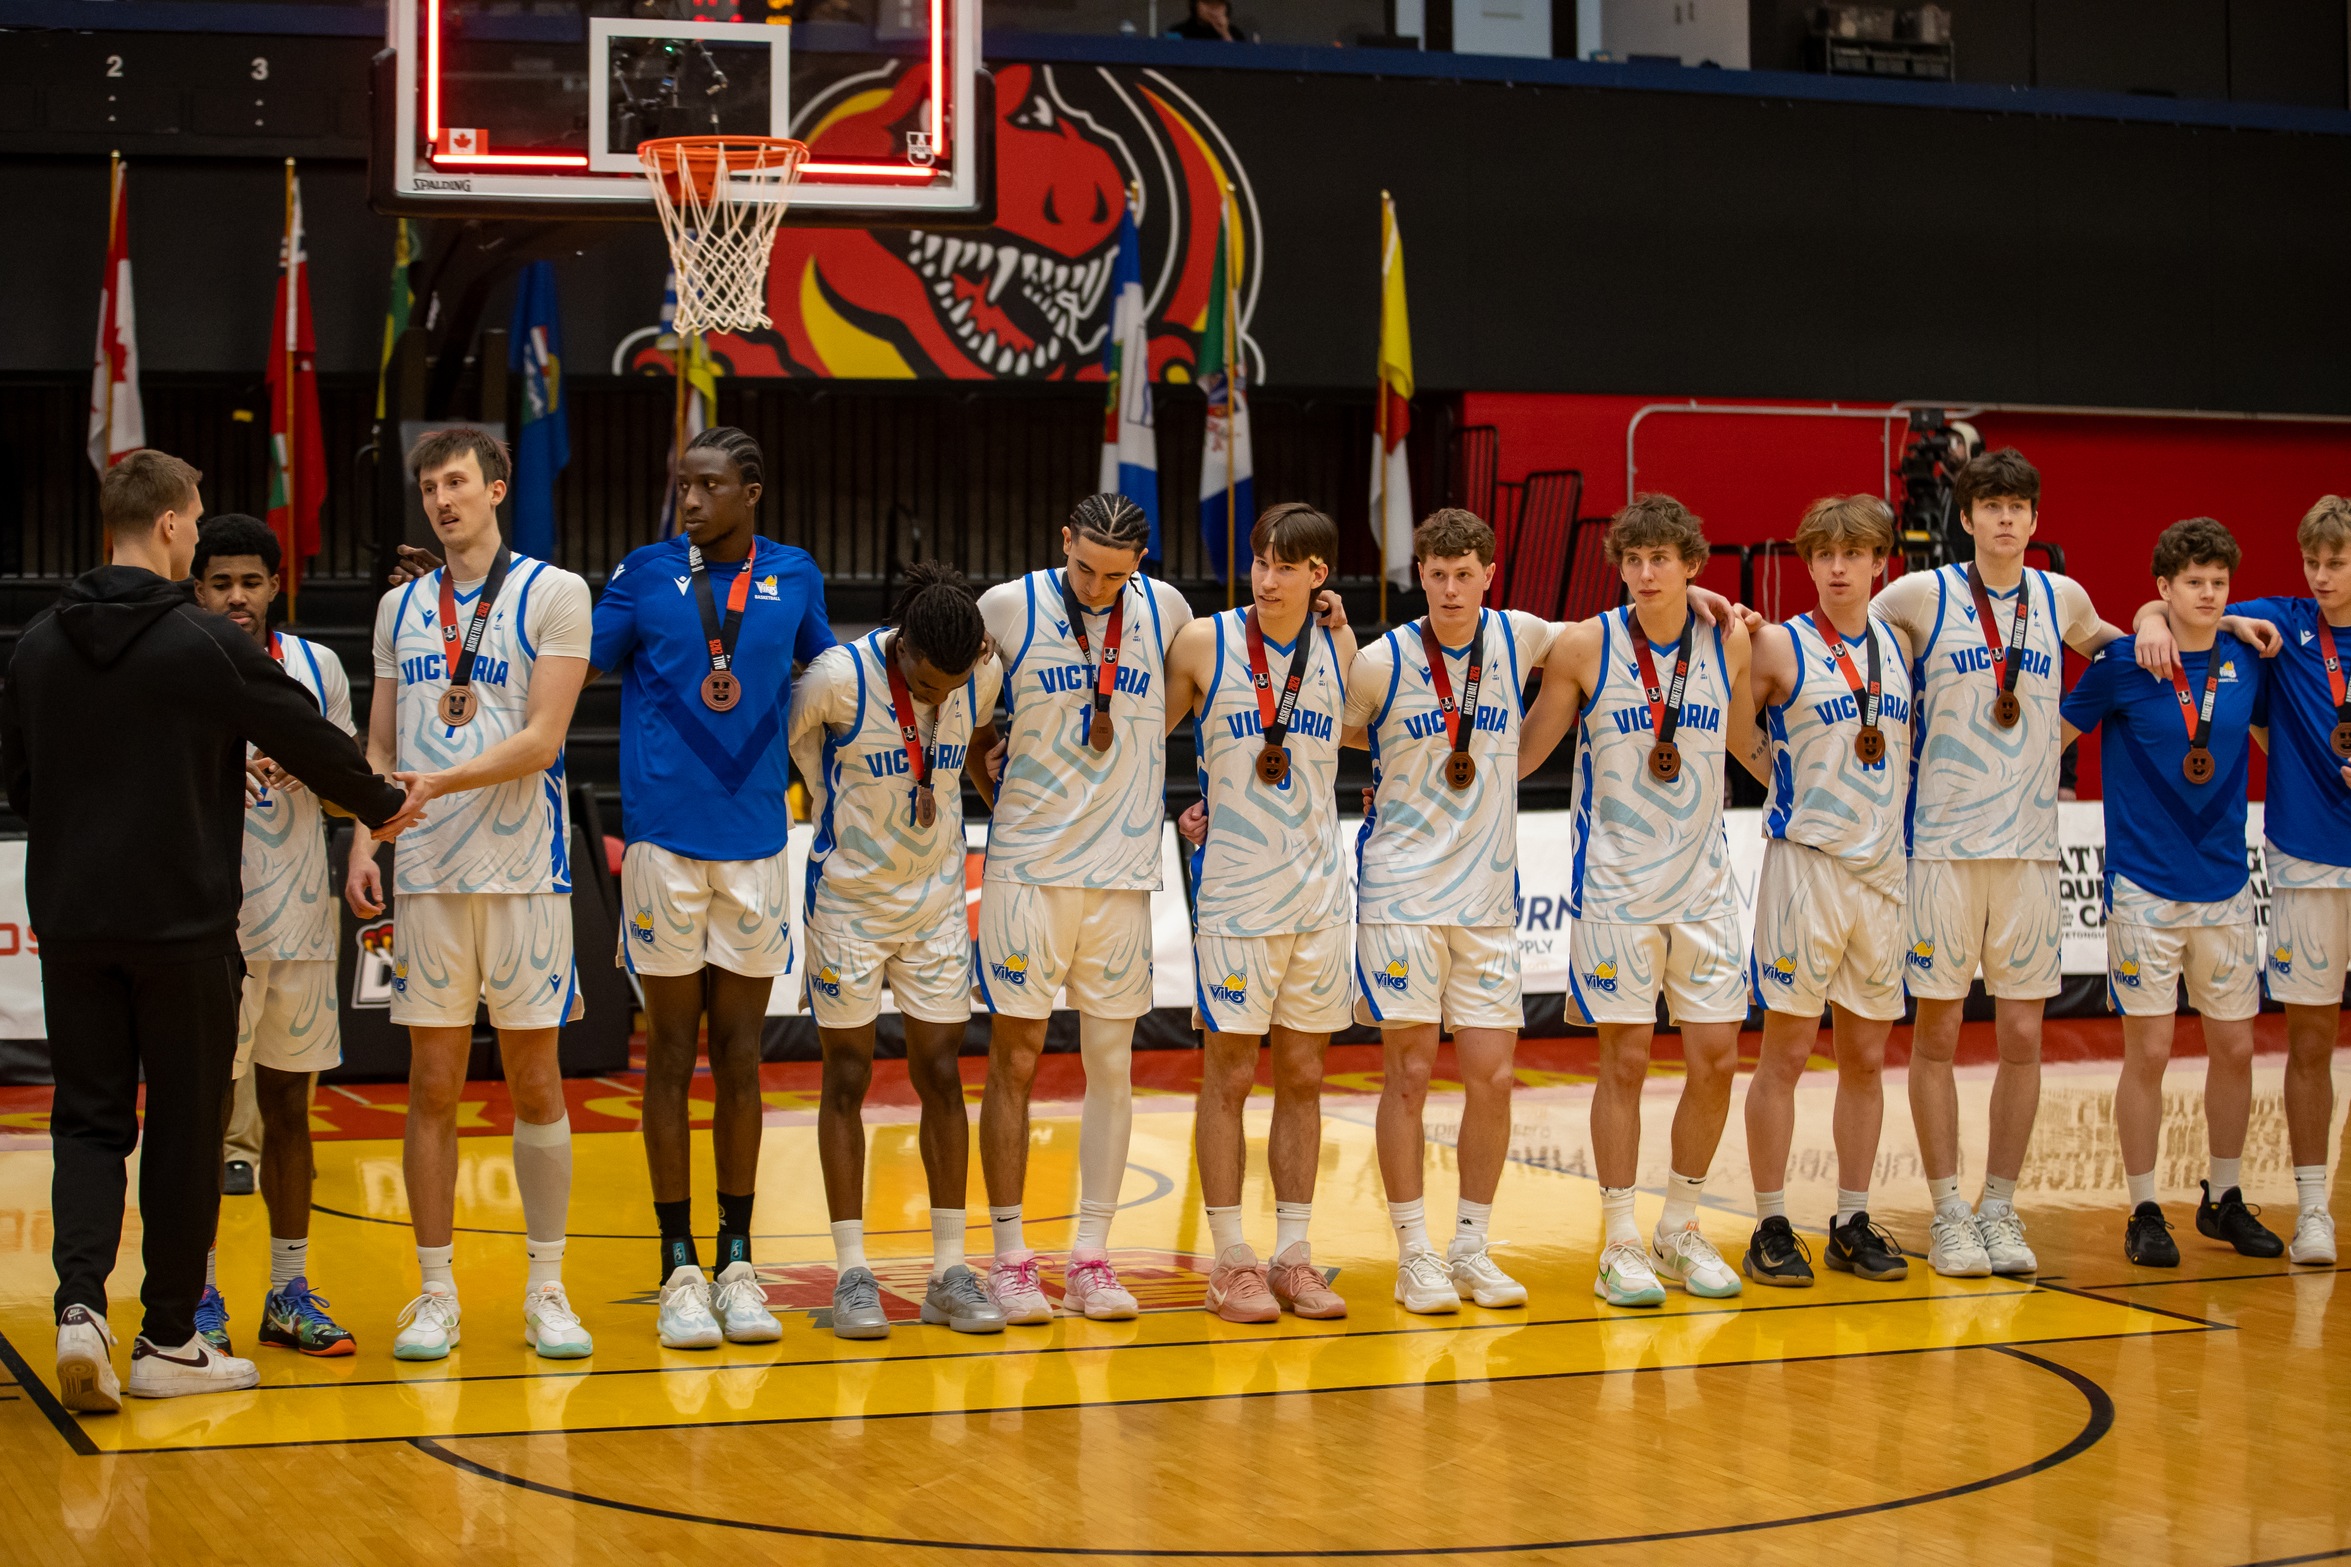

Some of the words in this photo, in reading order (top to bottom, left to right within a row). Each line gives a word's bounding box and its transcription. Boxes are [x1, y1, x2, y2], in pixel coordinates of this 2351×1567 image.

[106, 54, 124, 77] 2
[250, 57, 269, 80] 3
[413, 178, 472, 193] SPALDING
[464, 617, 486, 653] BASKETBALL
[476, 601, 491, 618] 2026
[401, 654, 509, 689] VICTRIA
[1469, 665, 1481, 682] 2026
[1675, 660, 1688, 677] 2026
[1950, 645, 2052, 680] VICRIA
[1037, 664, 1152, 699] VICTRIA
[1463, 681, 1479, 716] BASKETBALL
[1668, 675, 1685, 709] BASKETBALL
[1277, 690, 1297, 726] BASKETBALL
[1287, 674, 1301, 692] 2026
[1813, 693, 1909, 727] VICRIA
[1226, 707, 1334, 743] VICORIA
[1403, 705, 1509, 740] VICRIA
[864, 743, 967, 778] VICRIA
[989, 961, 1027, 987] Vikes
[1371, 970, 1408, 993] Vikes
[1581, 972, 1618, 994] Vikes
[1761, 961, 1795, 987] Vikes
[1207, 983, 1246, 1006] Vikes
